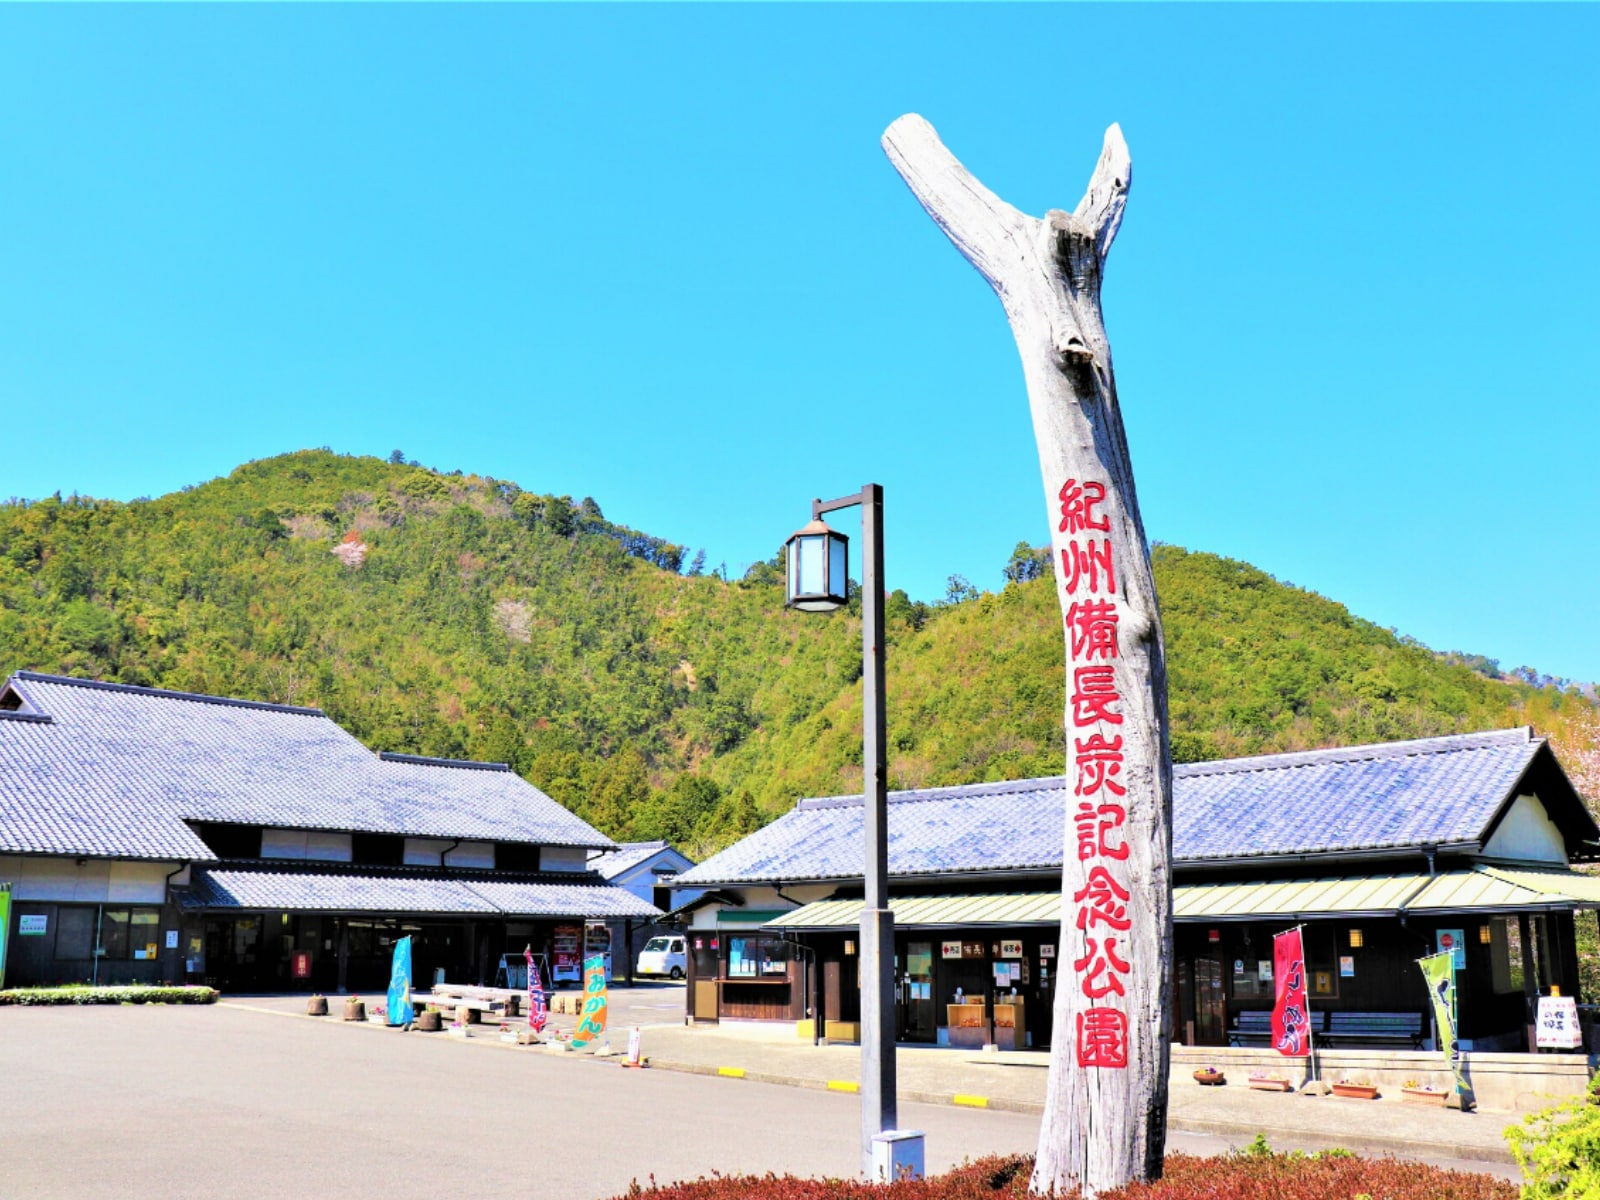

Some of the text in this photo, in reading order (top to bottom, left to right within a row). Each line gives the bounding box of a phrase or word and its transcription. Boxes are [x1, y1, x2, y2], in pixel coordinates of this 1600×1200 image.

[1058, 477, 1131, 1069] 紀州備長炭記念公園
[578, 973, 606, 1034] みかん
